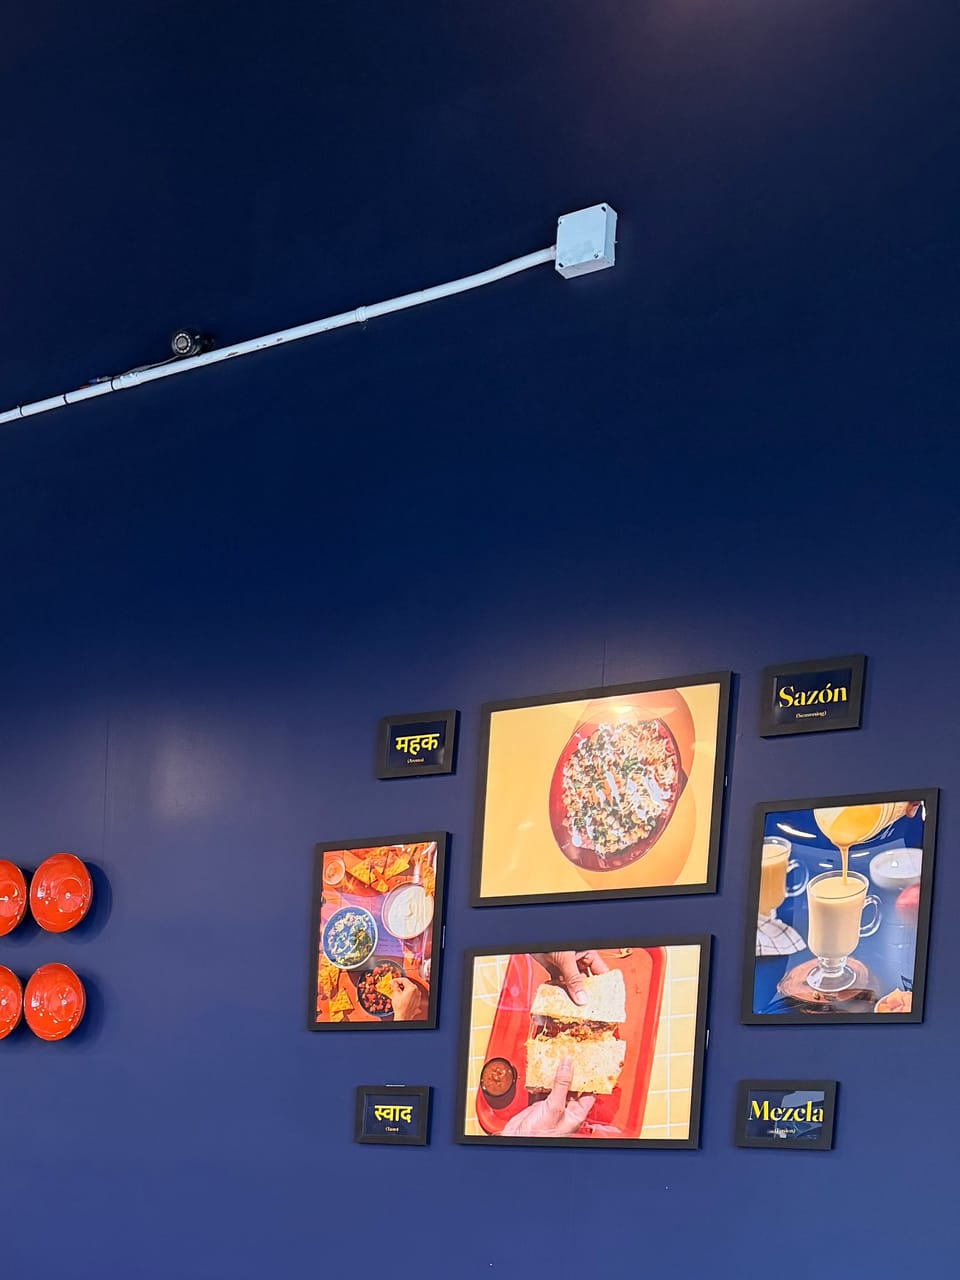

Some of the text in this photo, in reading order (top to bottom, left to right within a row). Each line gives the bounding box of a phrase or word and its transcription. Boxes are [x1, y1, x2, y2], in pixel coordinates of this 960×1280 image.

[779, 683, 847, 708] Sazón
[395, 733, 440, 756] महक
[374, 1105, 413, 1123] स्वाद
[748, 1100, 824, 1122] Mezcla
